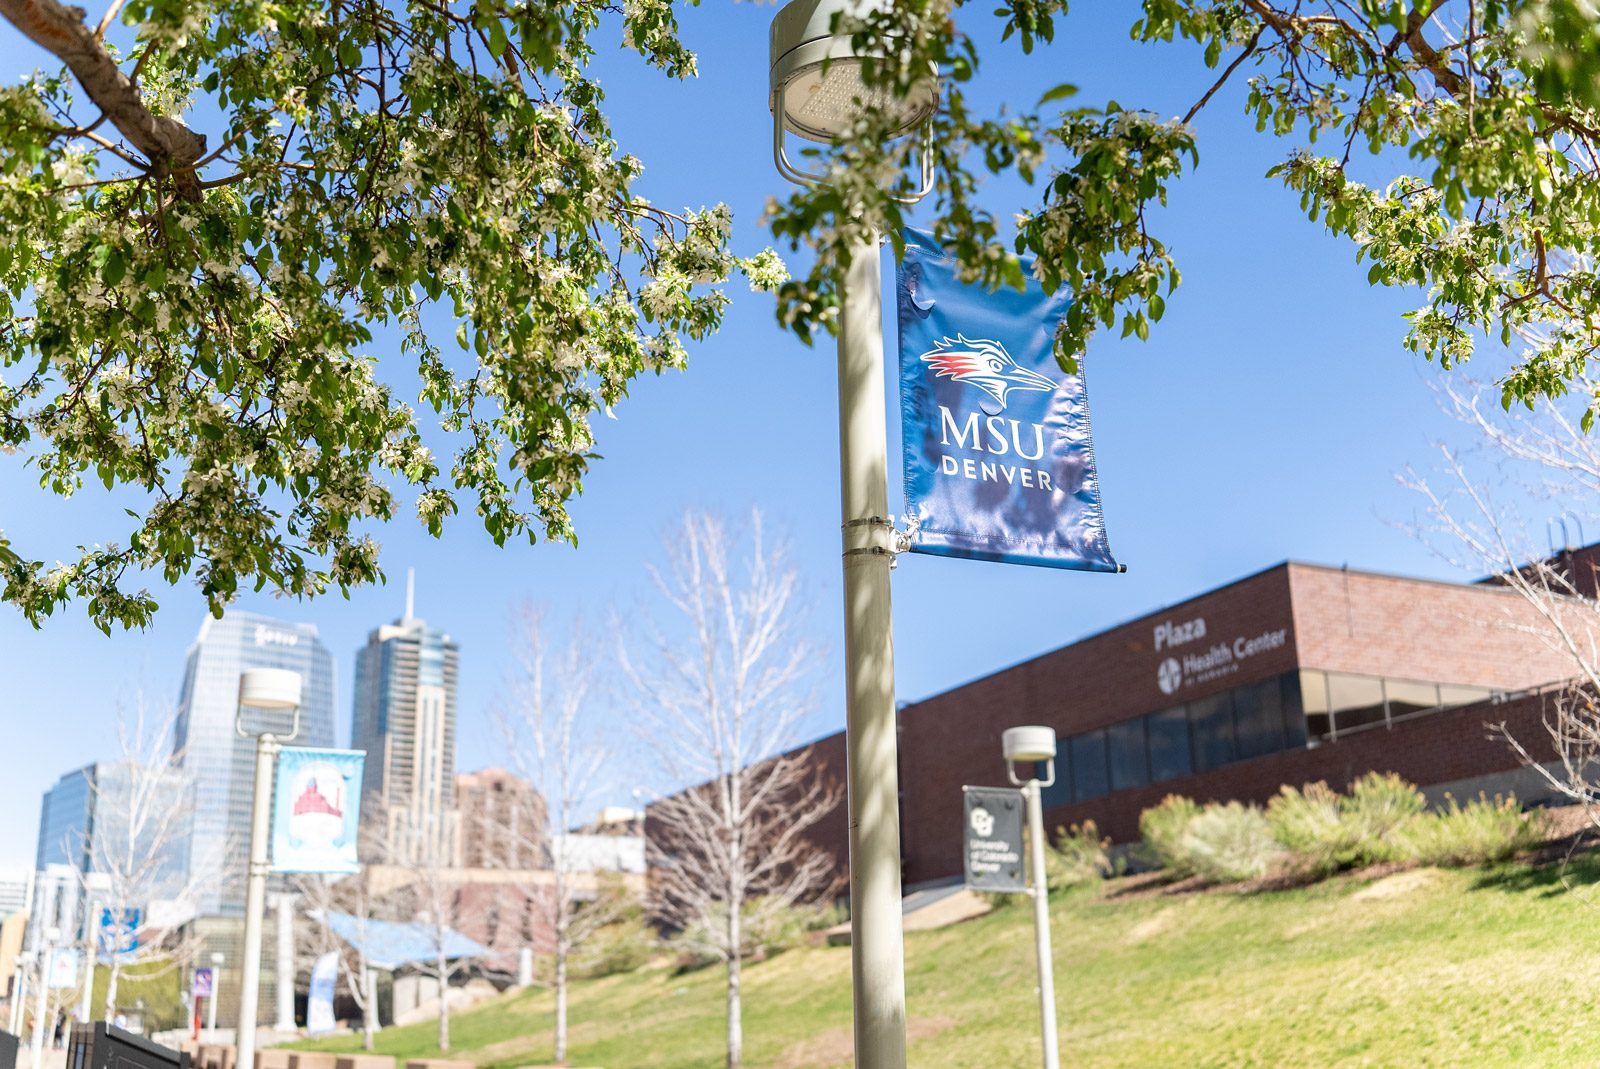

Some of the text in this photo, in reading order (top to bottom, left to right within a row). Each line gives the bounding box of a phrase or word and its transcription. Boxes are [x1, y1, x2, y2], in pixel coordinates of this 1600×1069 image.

[938, 405, 1044, 461] MSU
[942, 455, 1053, 491] DENVER
[1154, 617, 1207, 652] Plaza
[1183, 628, 1287, 674] Health Center
